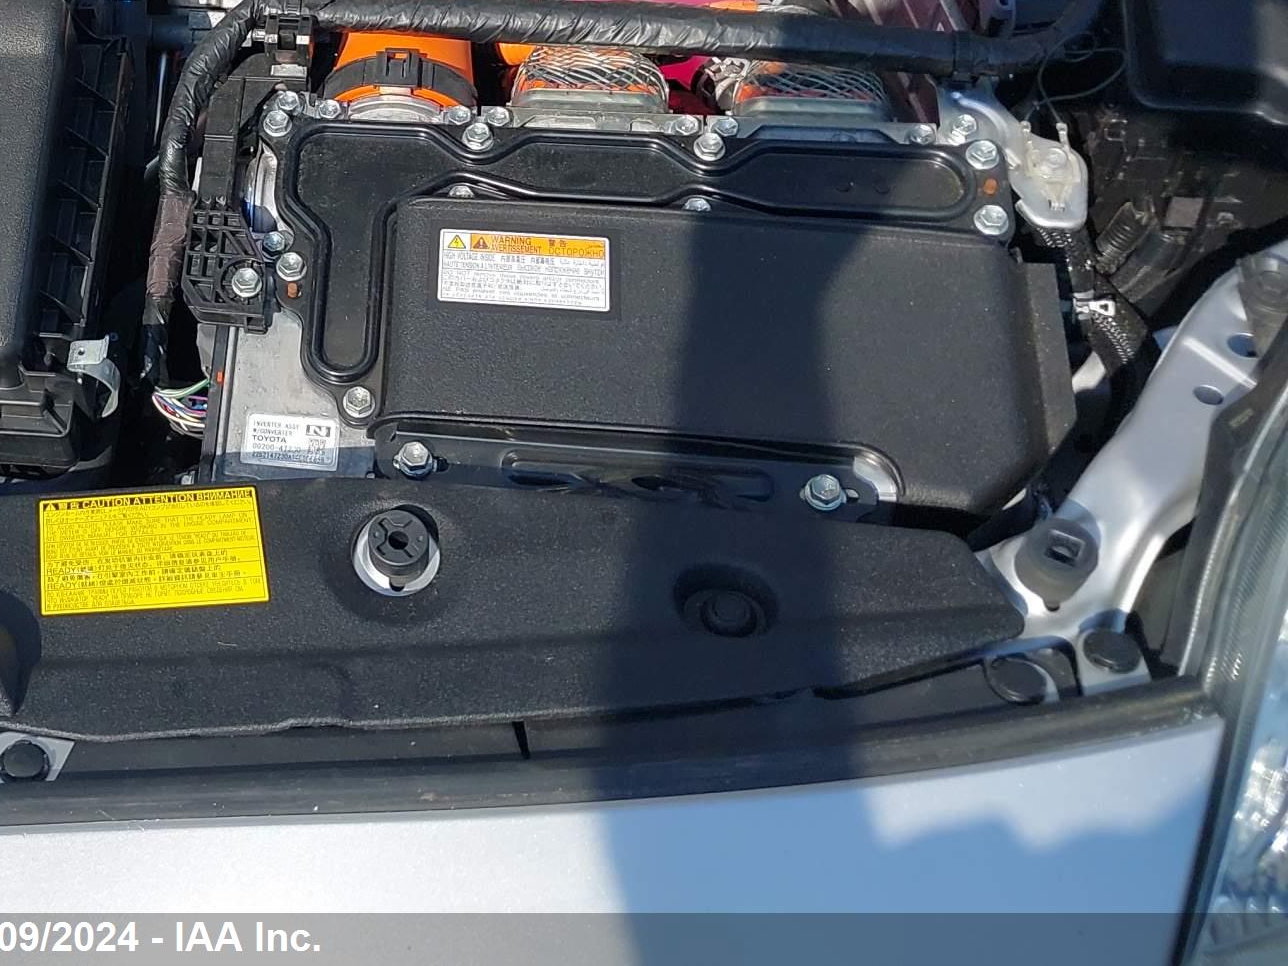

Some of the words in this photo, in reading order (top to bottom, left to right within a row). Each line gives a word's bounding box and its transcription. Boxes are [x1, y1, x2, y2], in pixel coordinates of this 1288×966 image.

[492, 235, 531, 245] WARNING
[490, 242, 541, 253] AVERTISSEMENT
[252, 435, 286, 443] TOYOTA
[81, 497, 130, 508] CAUTION
[133, 493, 194, 505] ATTENTION
[196, 489, 251, 500] ВНИМАНИЕ
